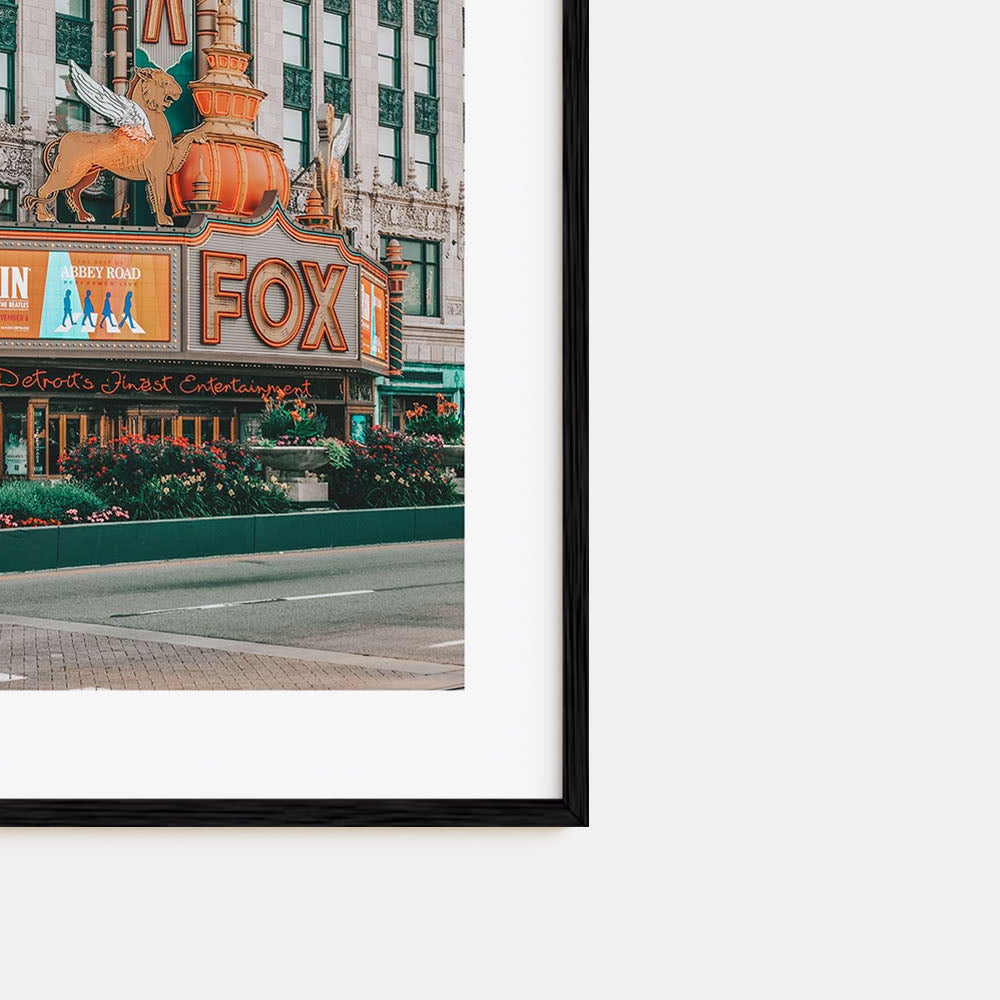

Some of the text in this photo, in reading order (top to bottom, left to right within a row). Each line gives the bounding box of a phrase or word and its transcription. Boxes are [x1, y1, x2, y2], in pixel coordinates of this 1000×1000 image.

[60, 265, 142, 280] ABBEY ROAD
[9, 300, 30, 309] BEATLES
[200, 250, 349, 352] FOX
[101, 370, 173, 395] Finest
[180, 374, 312, 397] Entertainment
